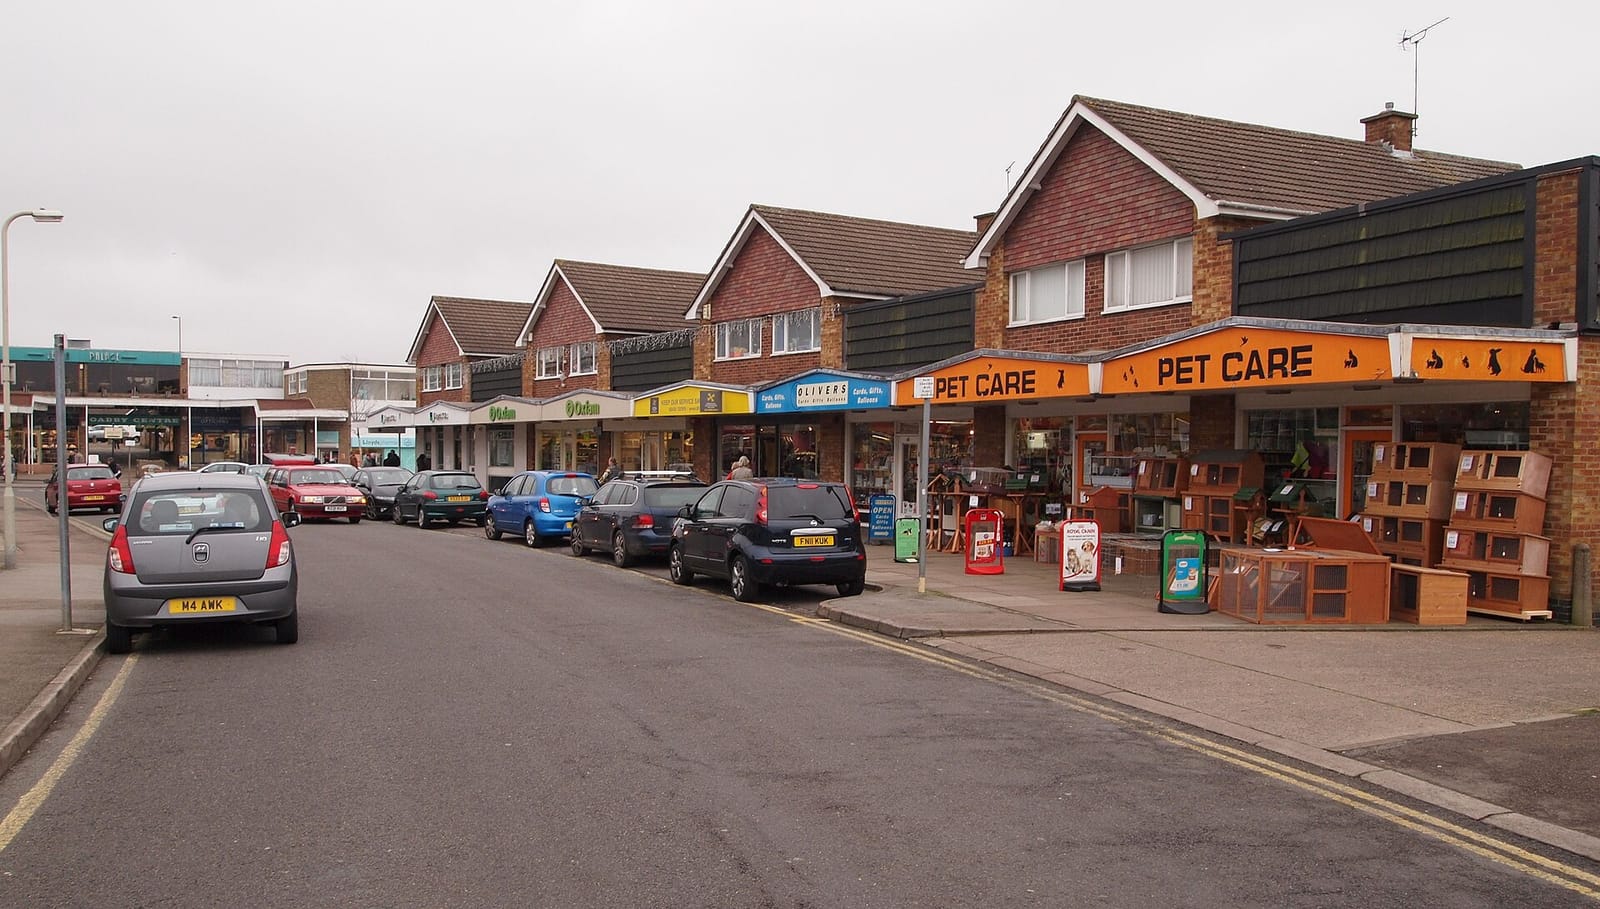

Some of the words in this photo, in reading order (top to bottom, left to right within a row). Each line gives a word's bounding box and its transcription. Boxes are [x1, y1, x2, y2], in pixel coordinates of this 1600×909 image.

[1158, 354, 1211, 386] PET
[1221, 345, 1313, 382] CARE
[798, 384, 846, 396] OLIVERS
[936, 375, 968, 399] PET
[976, 370, 1036, 397] CARE
[496, 406, 516, 420] Oxfam
[575, 400, 600, 415] Oxfam
[814, 537, 829, 545] KUK
[182, 601, 197, 611] M4
[201, 600, 223, 610] AWK
